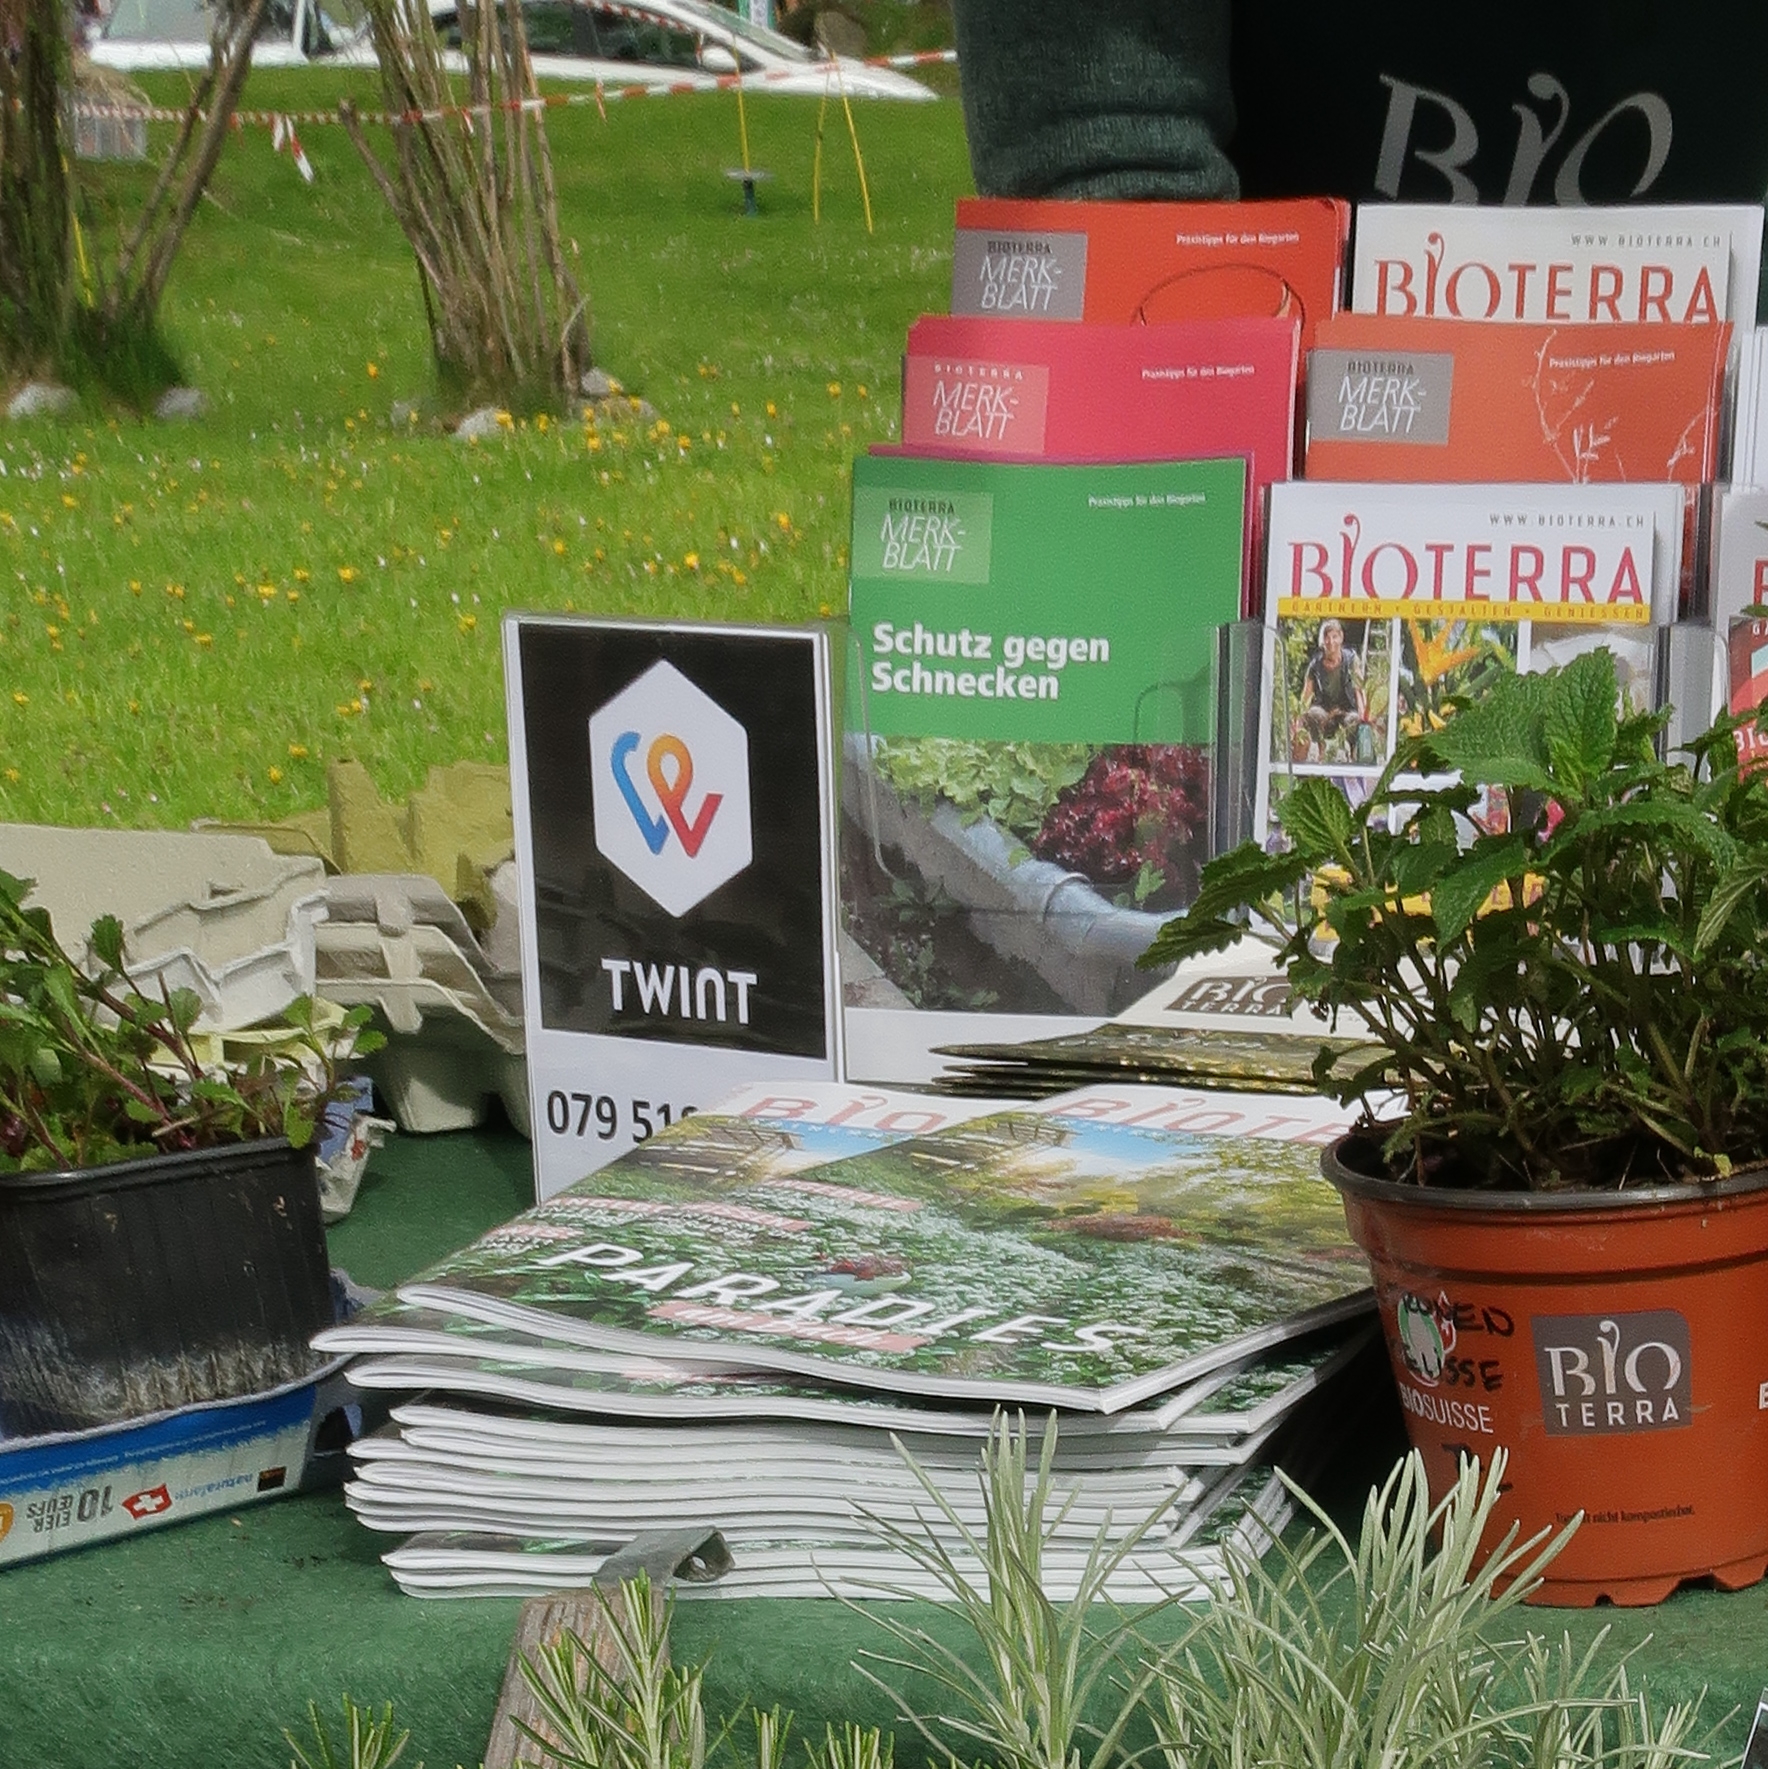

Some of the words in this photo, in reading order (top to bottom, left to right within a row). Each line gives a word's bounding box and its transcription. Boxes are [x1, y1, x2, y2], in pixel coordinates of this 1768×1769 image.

[1374, 72, 1673, 205] BIO
[987, 239, 1052, 255] BIOTERRA
[1374, 230, 1718, 323] BIOTERRA
[981, 281, 1057, 312] BLATT
[934, 363, 1024, 380] BIOTERRA
[1347, 360, 1415, 375] BIOTERRA
[934, 407, 1014, 440] BLATT
[1340, 403, 1421, 434] BLATT
[888, 497, 955, 514] BIOTERRA
[882, 541, 963, 572] BLATT
[1287, 513, 1644, 604] BIOTERRA
[872, 622, 992, 660] Schutz
[1003, 631, 1110, 670] gegen
[871, 661, 1060, 700] Schnecken
[600, 958, 758, 1025] TWINT
[1181, 1000, 1282, 1016] TERRA
[546, 1089, 618, 1140] 079
[534, 1241, 1147, 1354] PARADIES
[1544, 1319, 1683, 1397] BIO
[1555, 1397, 1681, 1428] TERRA
[77, 1485, 114, 1523] 10
[33, 1509, 70, 1534] EIER
